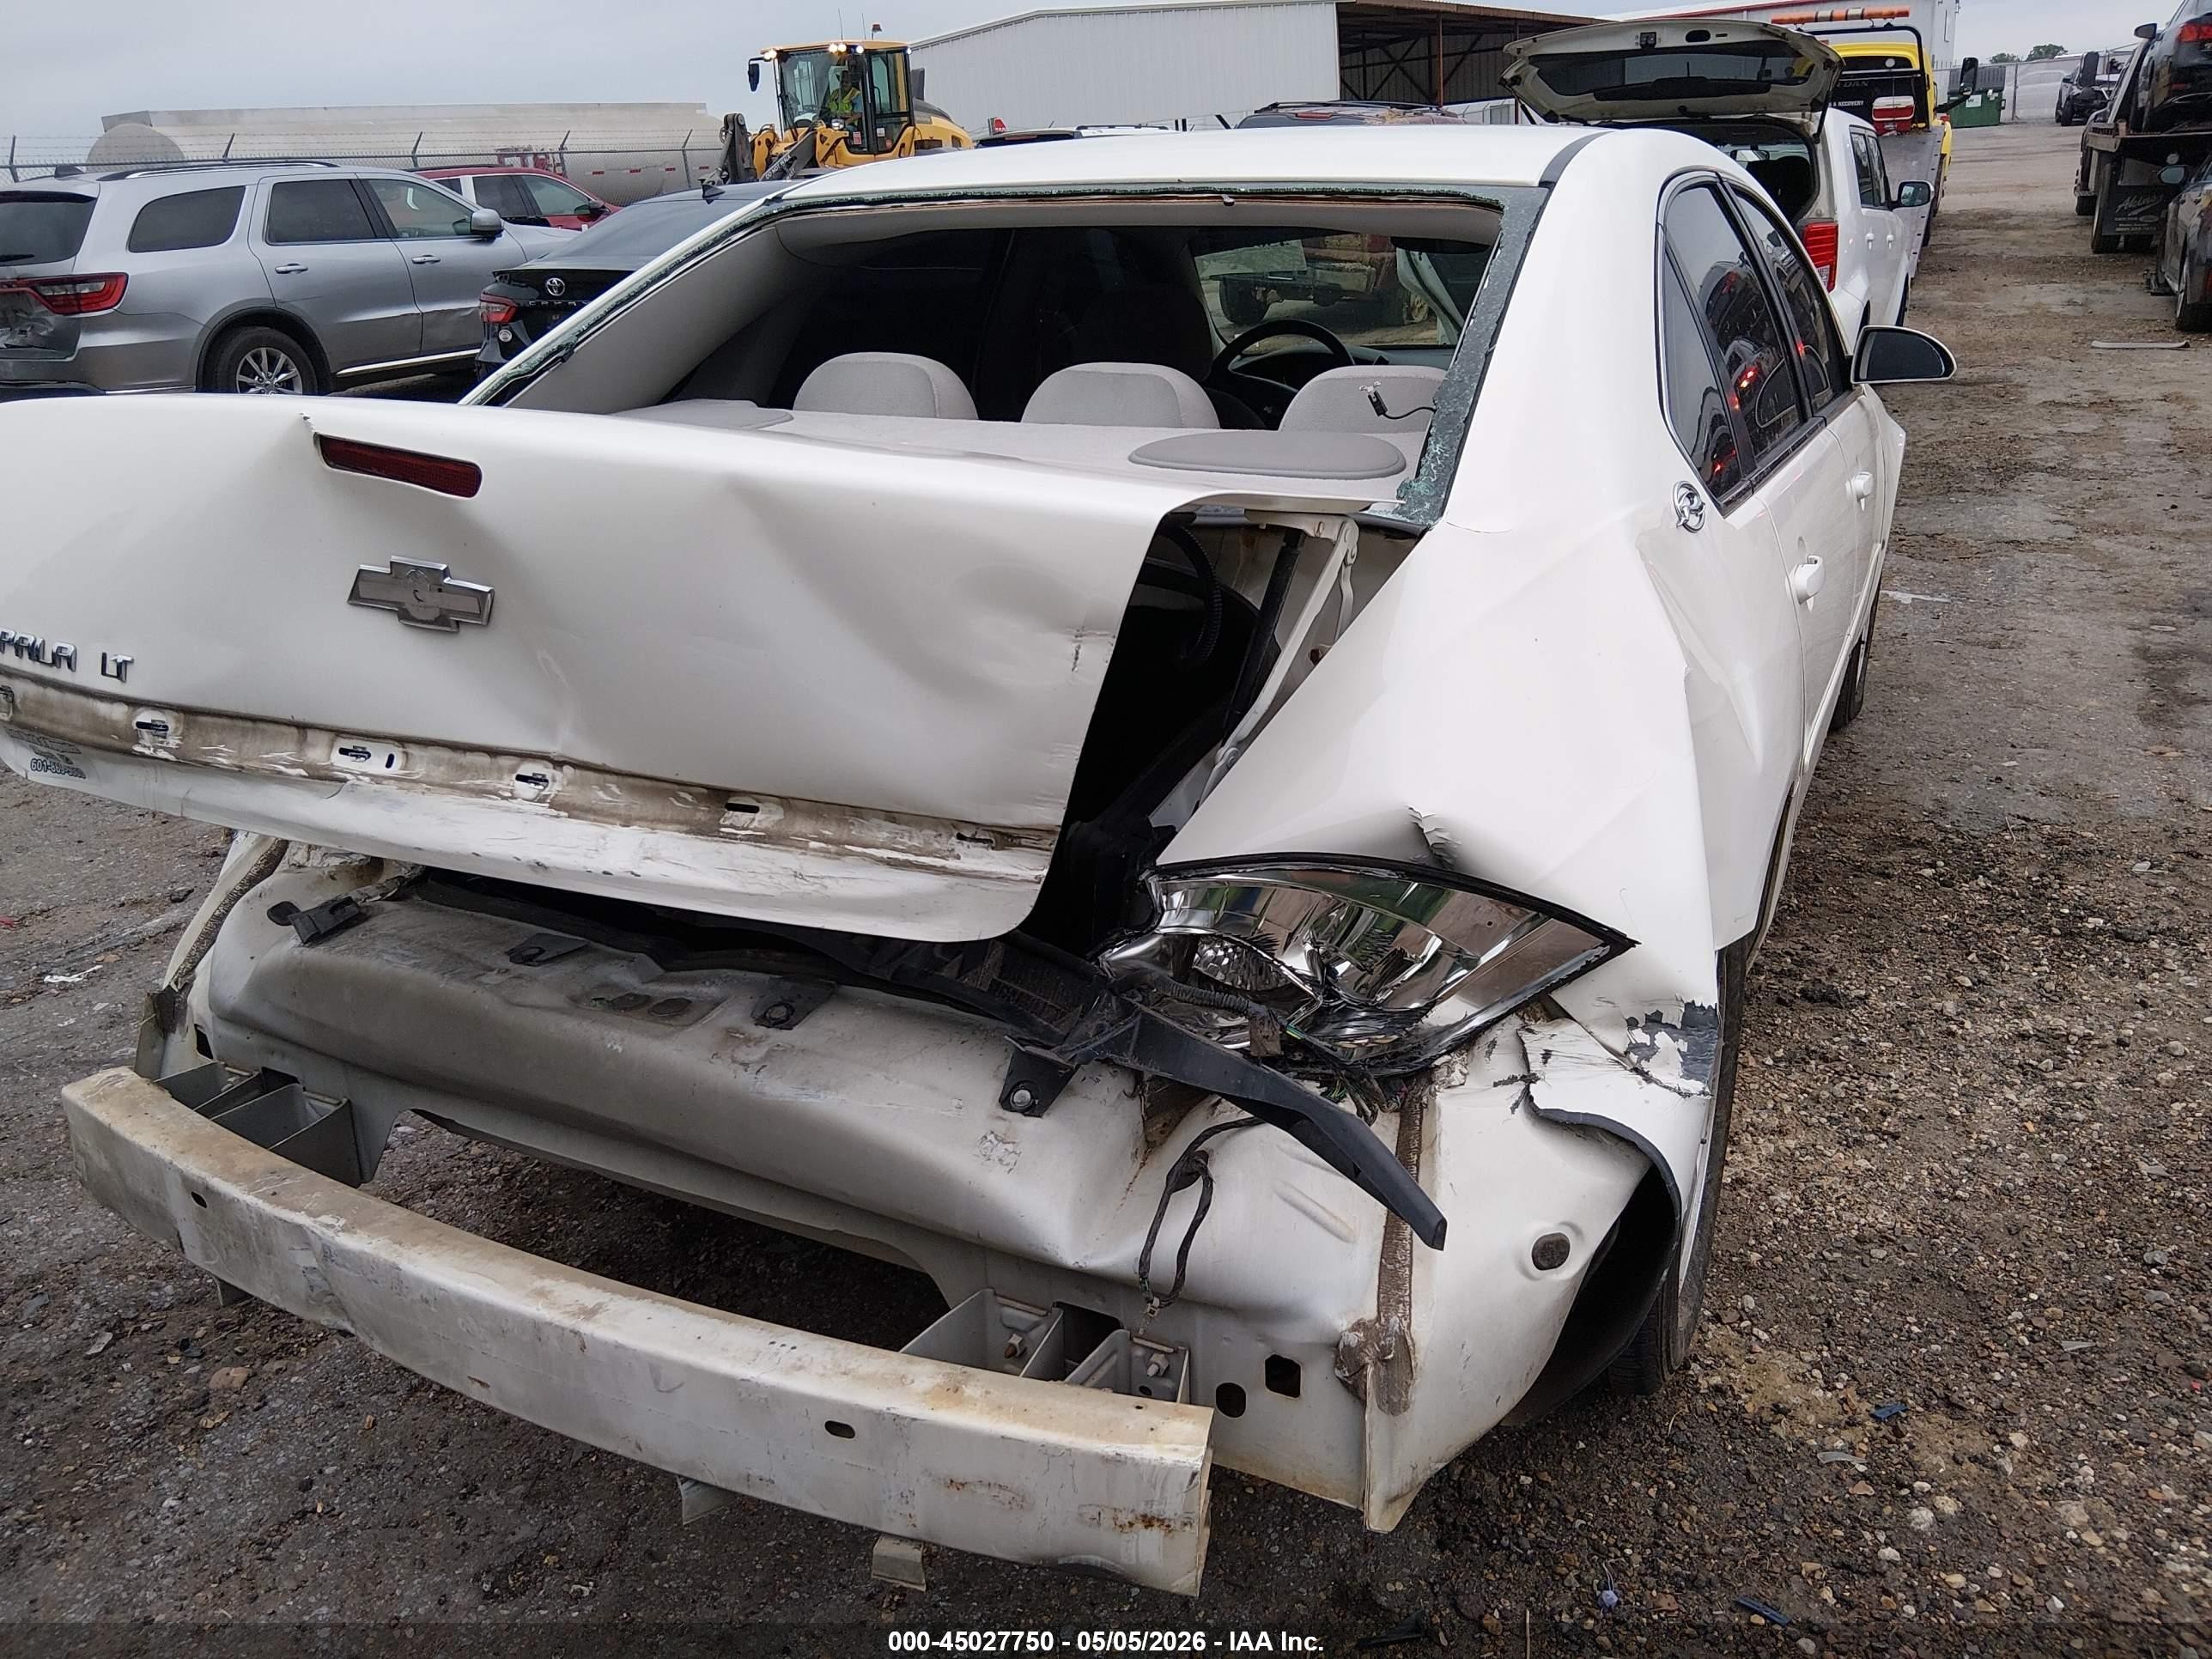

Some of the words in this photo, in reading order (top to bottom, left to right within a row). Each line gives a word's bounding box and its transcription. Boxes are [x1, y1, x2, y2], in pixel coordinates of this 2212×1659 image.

[772, 163, 781, 173] NOT
[780, 155, 791, 167] WALK
[100, 652, 134, 684] LT
